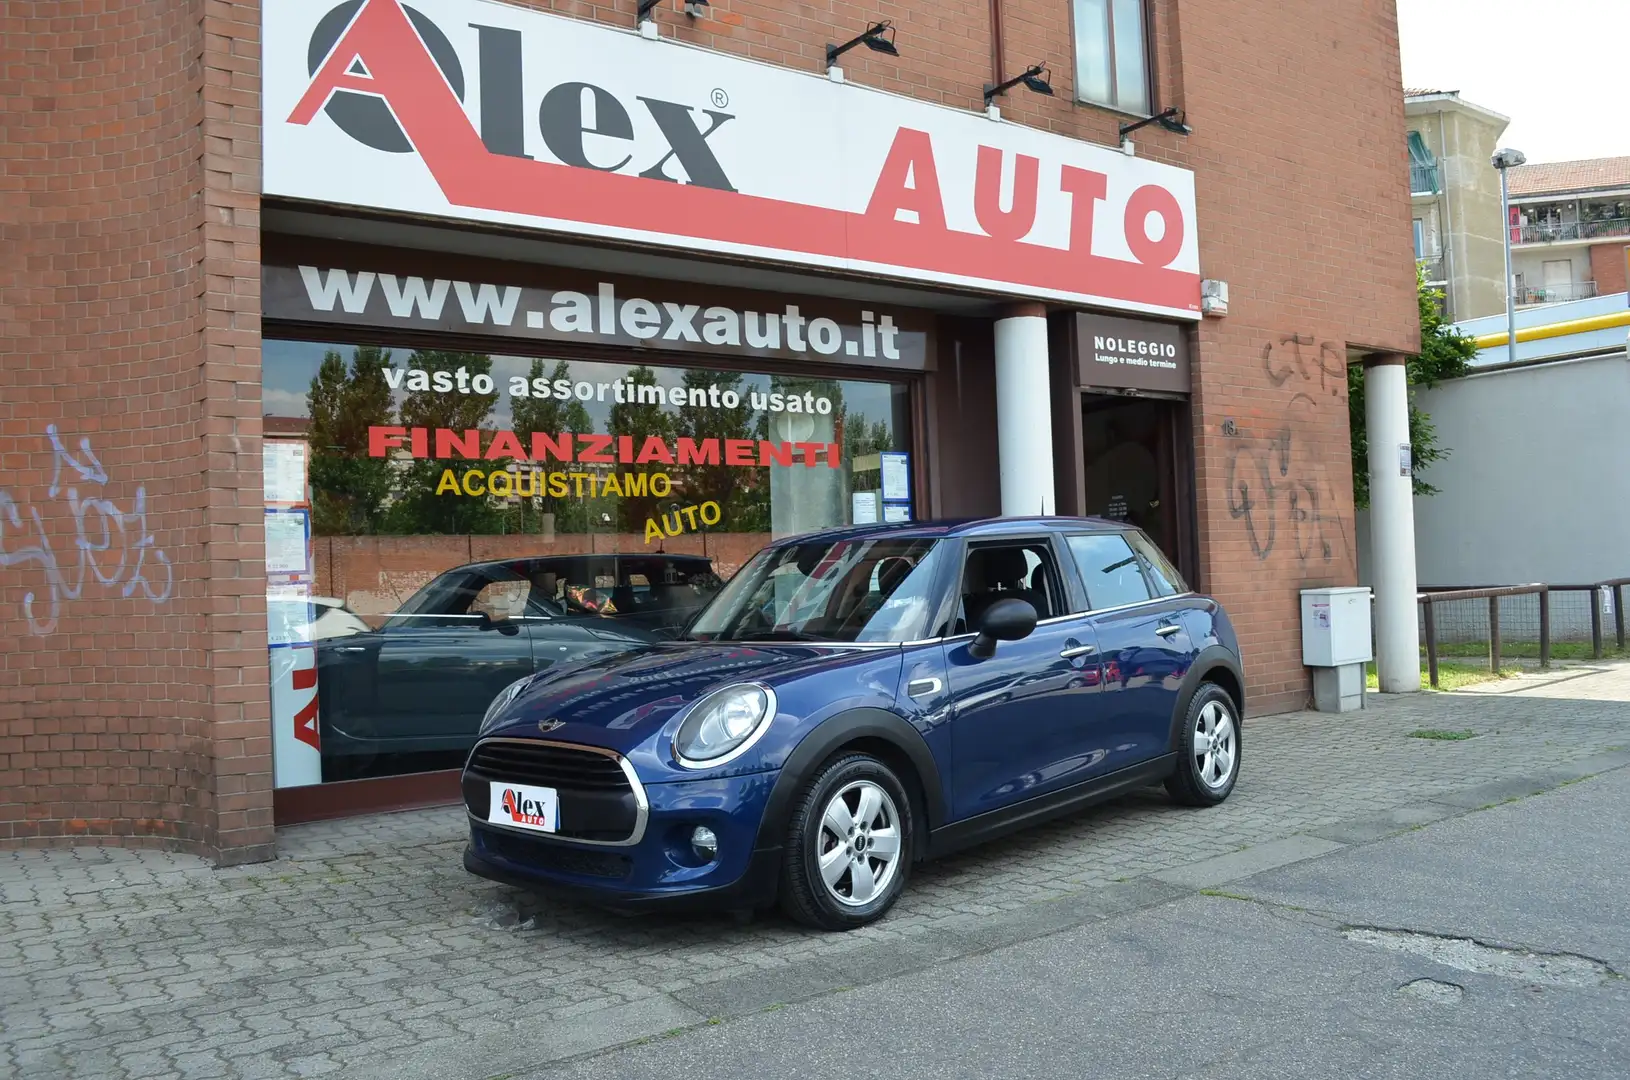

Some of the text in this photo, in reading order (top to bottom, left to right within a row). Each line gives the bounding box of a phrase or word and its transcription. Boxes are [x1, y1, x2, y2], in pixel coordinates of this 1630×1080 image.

[286, 0, 738, 205] Alex
[864, 126, 1185, 267] AUTO
[298, 265, 900, 360] www.alexauto.it
[1094, 336, 1176, 358] NOLEGGIO
[1095, 353, 1118, 364] Lungo
[1126, 357, 1148, 366] medio
[1149, 359, 1177, 369] termine
[381, 365, 832, 415] vasto assortimento usato
[368, 426, 842, 469] FINANZIAMENTI
[435, 469, 671, 498] ACQUISTIAMO
[644, 500, 721, 545] AUTO
[501, 788, 546, 821] Alex
[521, 815, 545, 825] AUTO
